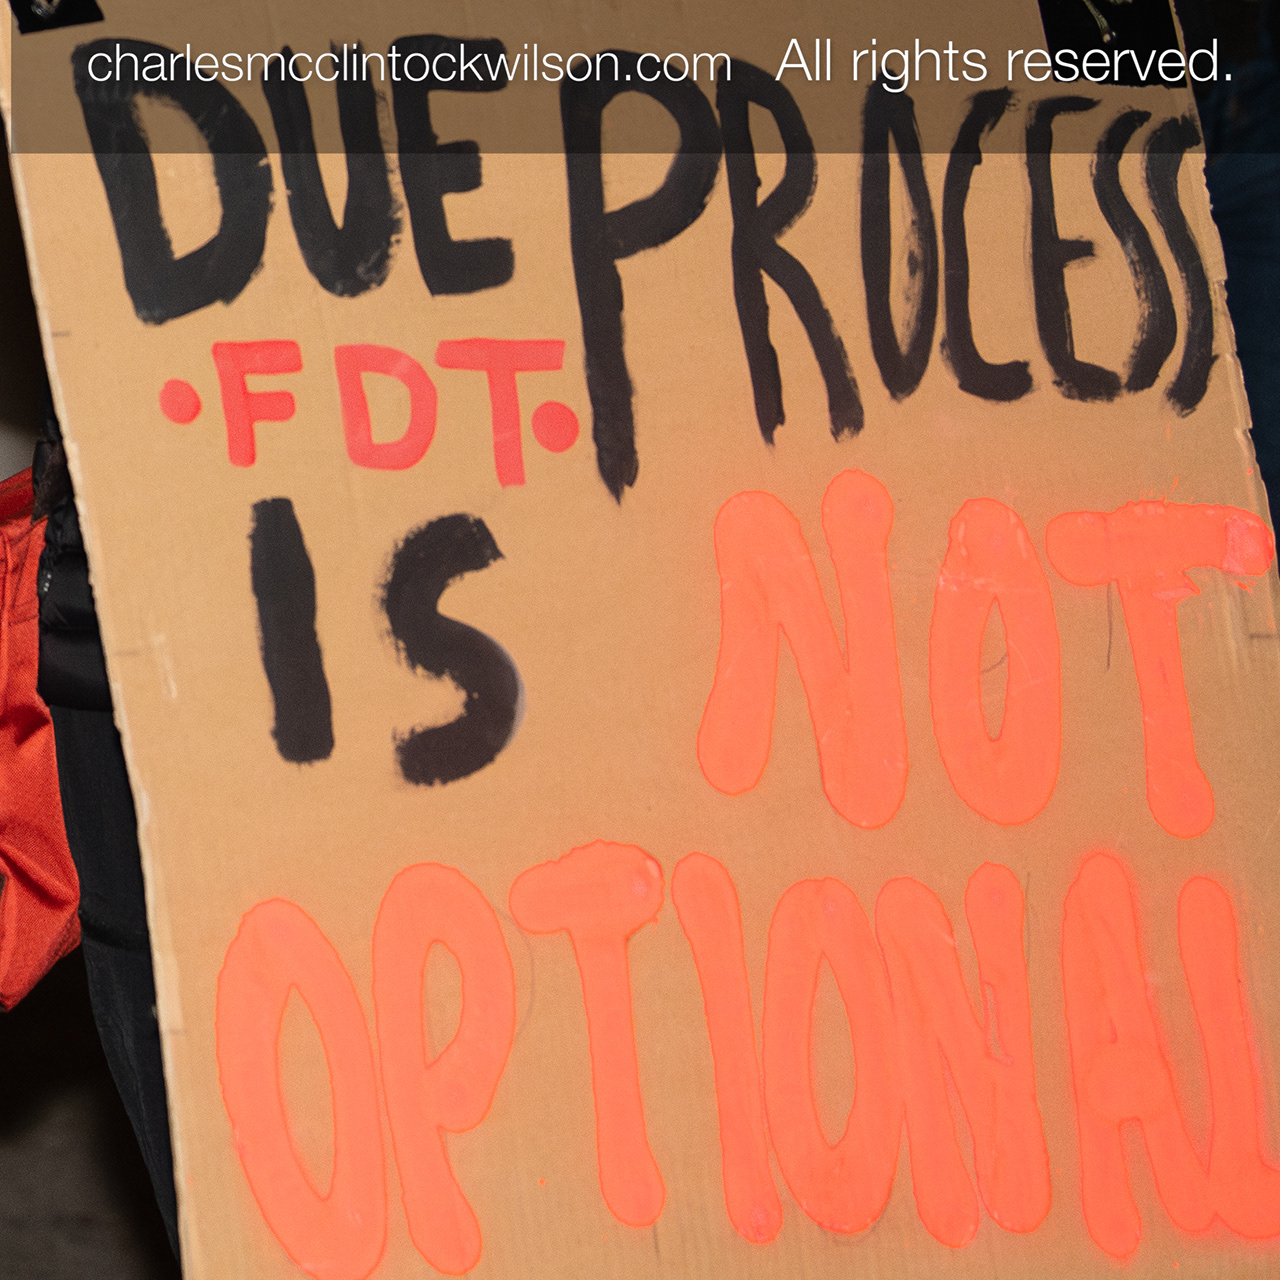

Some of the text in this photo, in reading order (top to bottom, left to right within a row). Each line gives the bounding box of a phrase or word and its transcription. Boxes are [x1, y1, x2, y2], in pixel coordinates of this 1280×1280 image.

[70, 35, 1220, 505] DUE PROCESS
[250, 496, 526, 786] IS
[697, 469, 1274, 838] NOT
[215, 841, 1280, 1280] OPTIONAL
